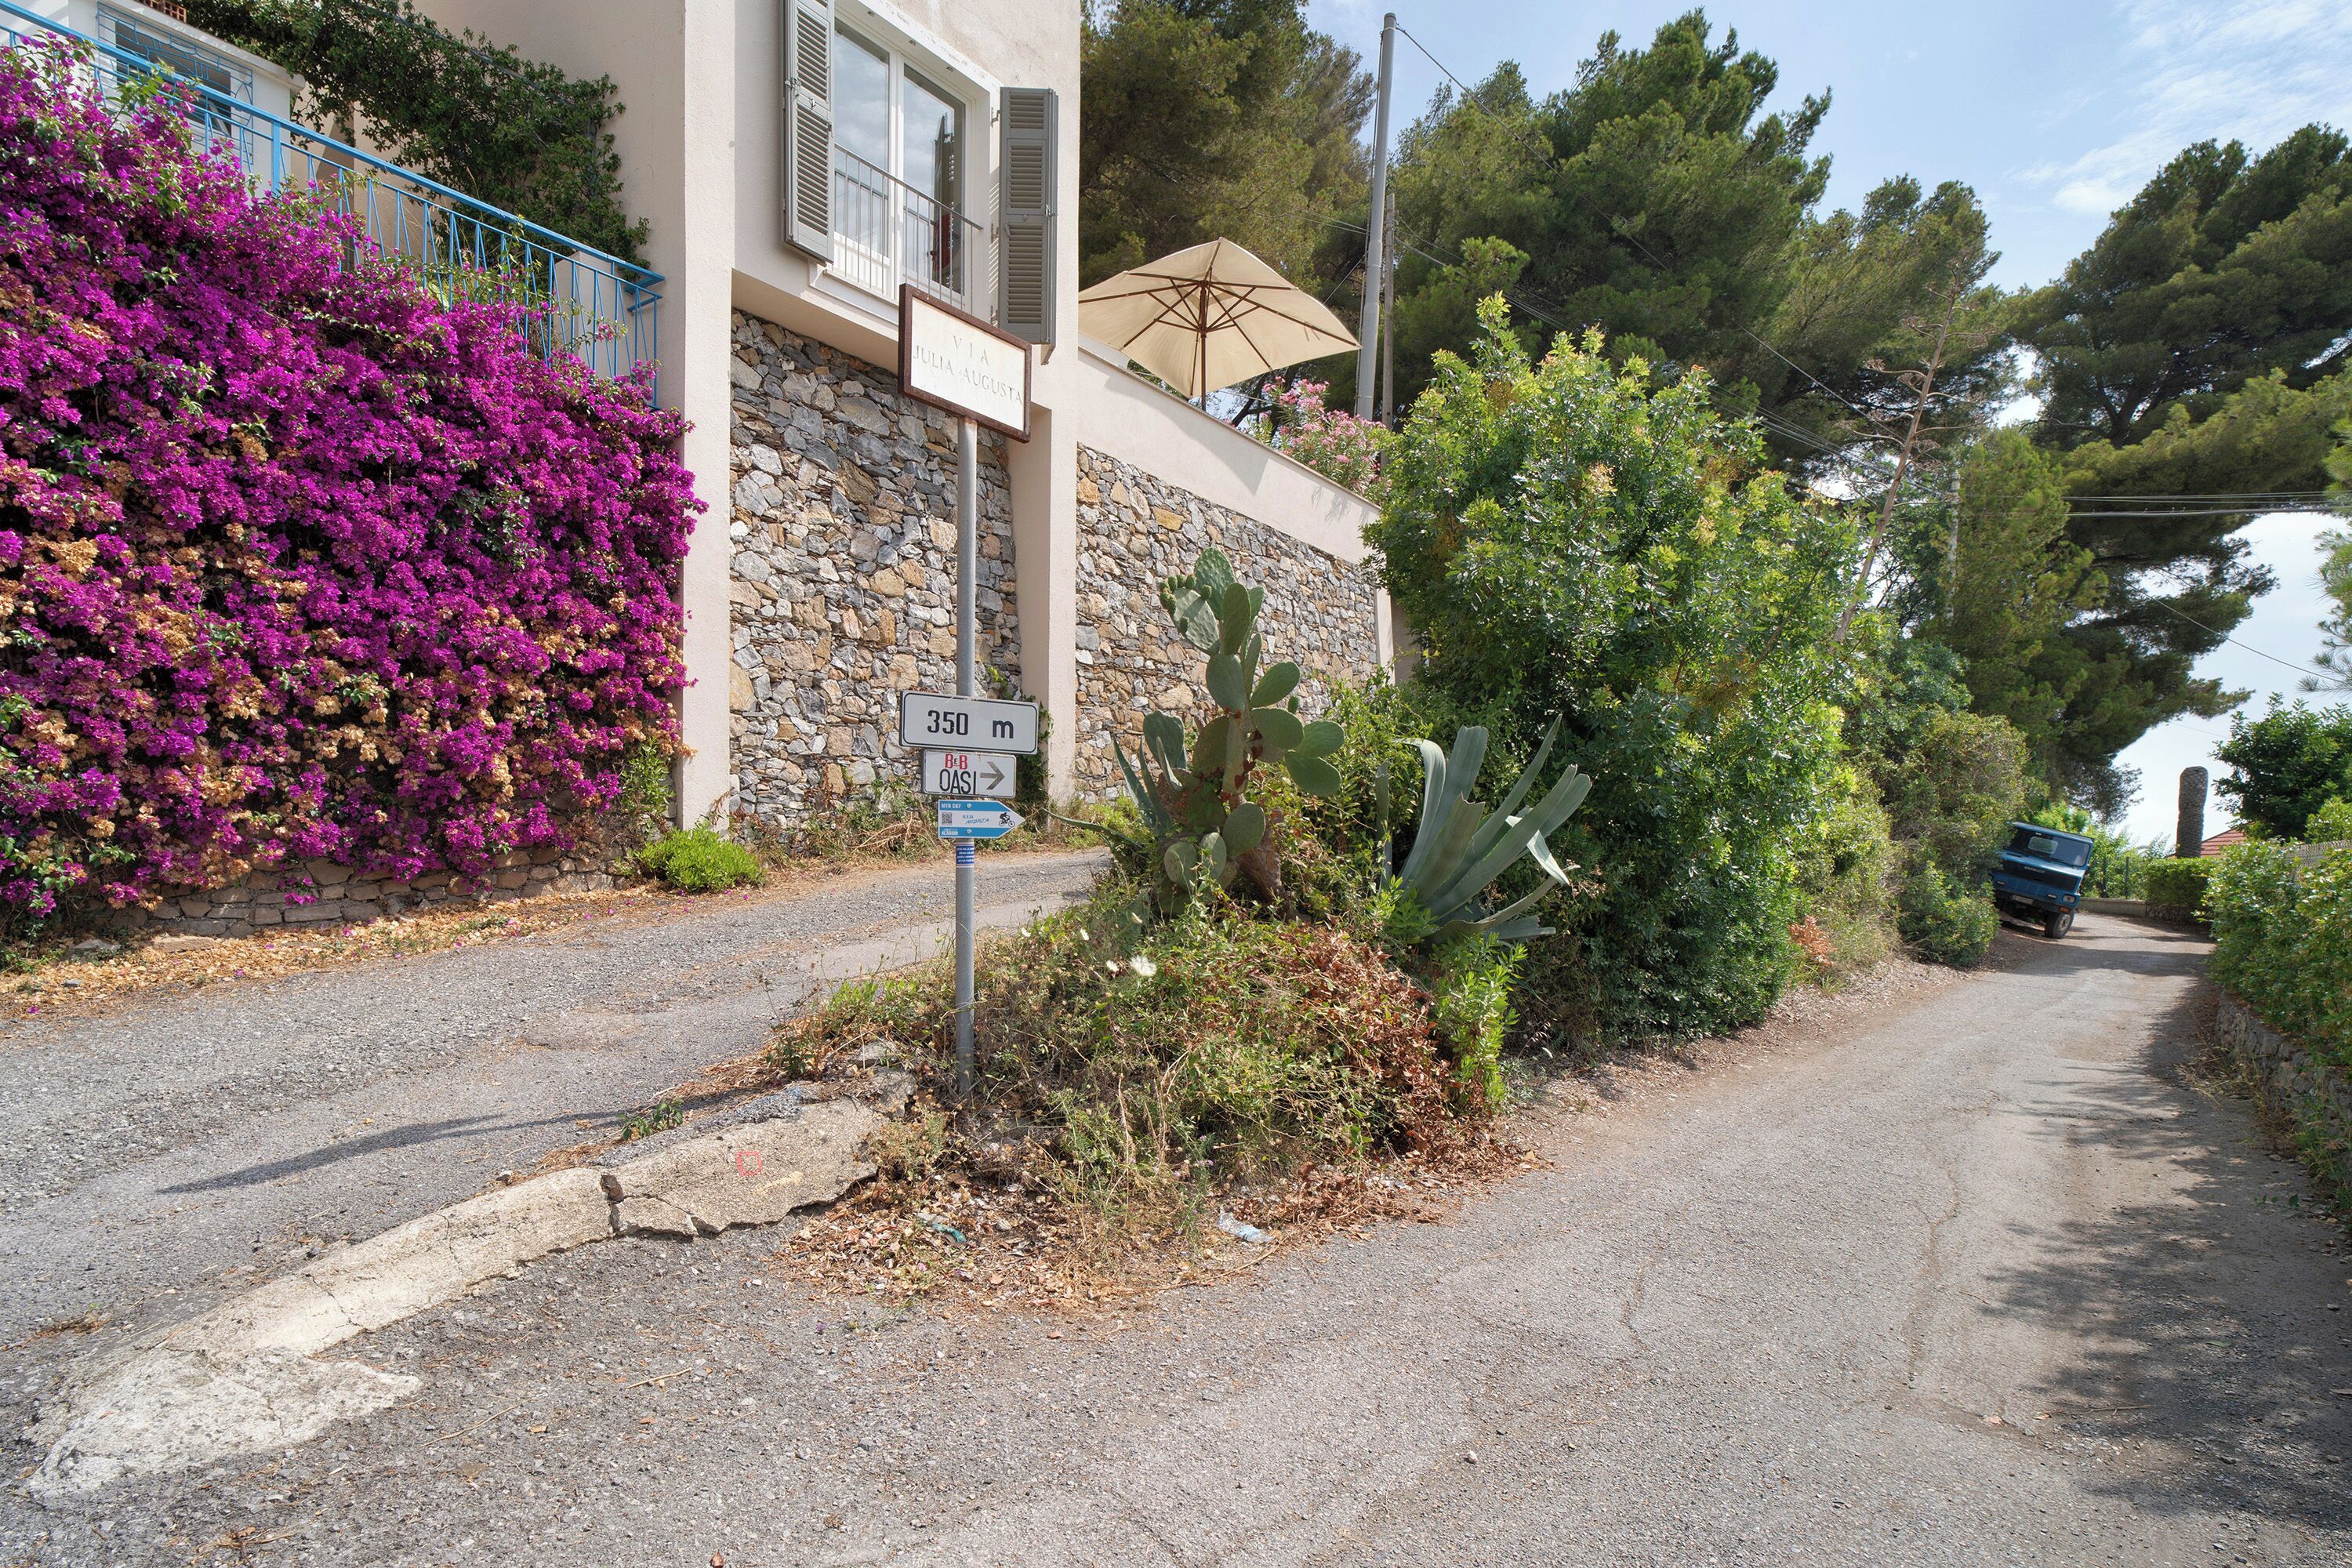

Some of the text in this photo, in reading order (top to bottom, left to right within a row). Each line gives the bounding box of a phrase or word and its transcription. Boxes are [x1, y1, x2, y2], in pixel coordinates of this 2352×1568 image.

[953, 335, 989, 365] VIA
[913, 344, 1023, 405] JULIA AUGUSTA
[927, 710, 1014, 739] 350 m
[939, 768, 977, 795] OASI
